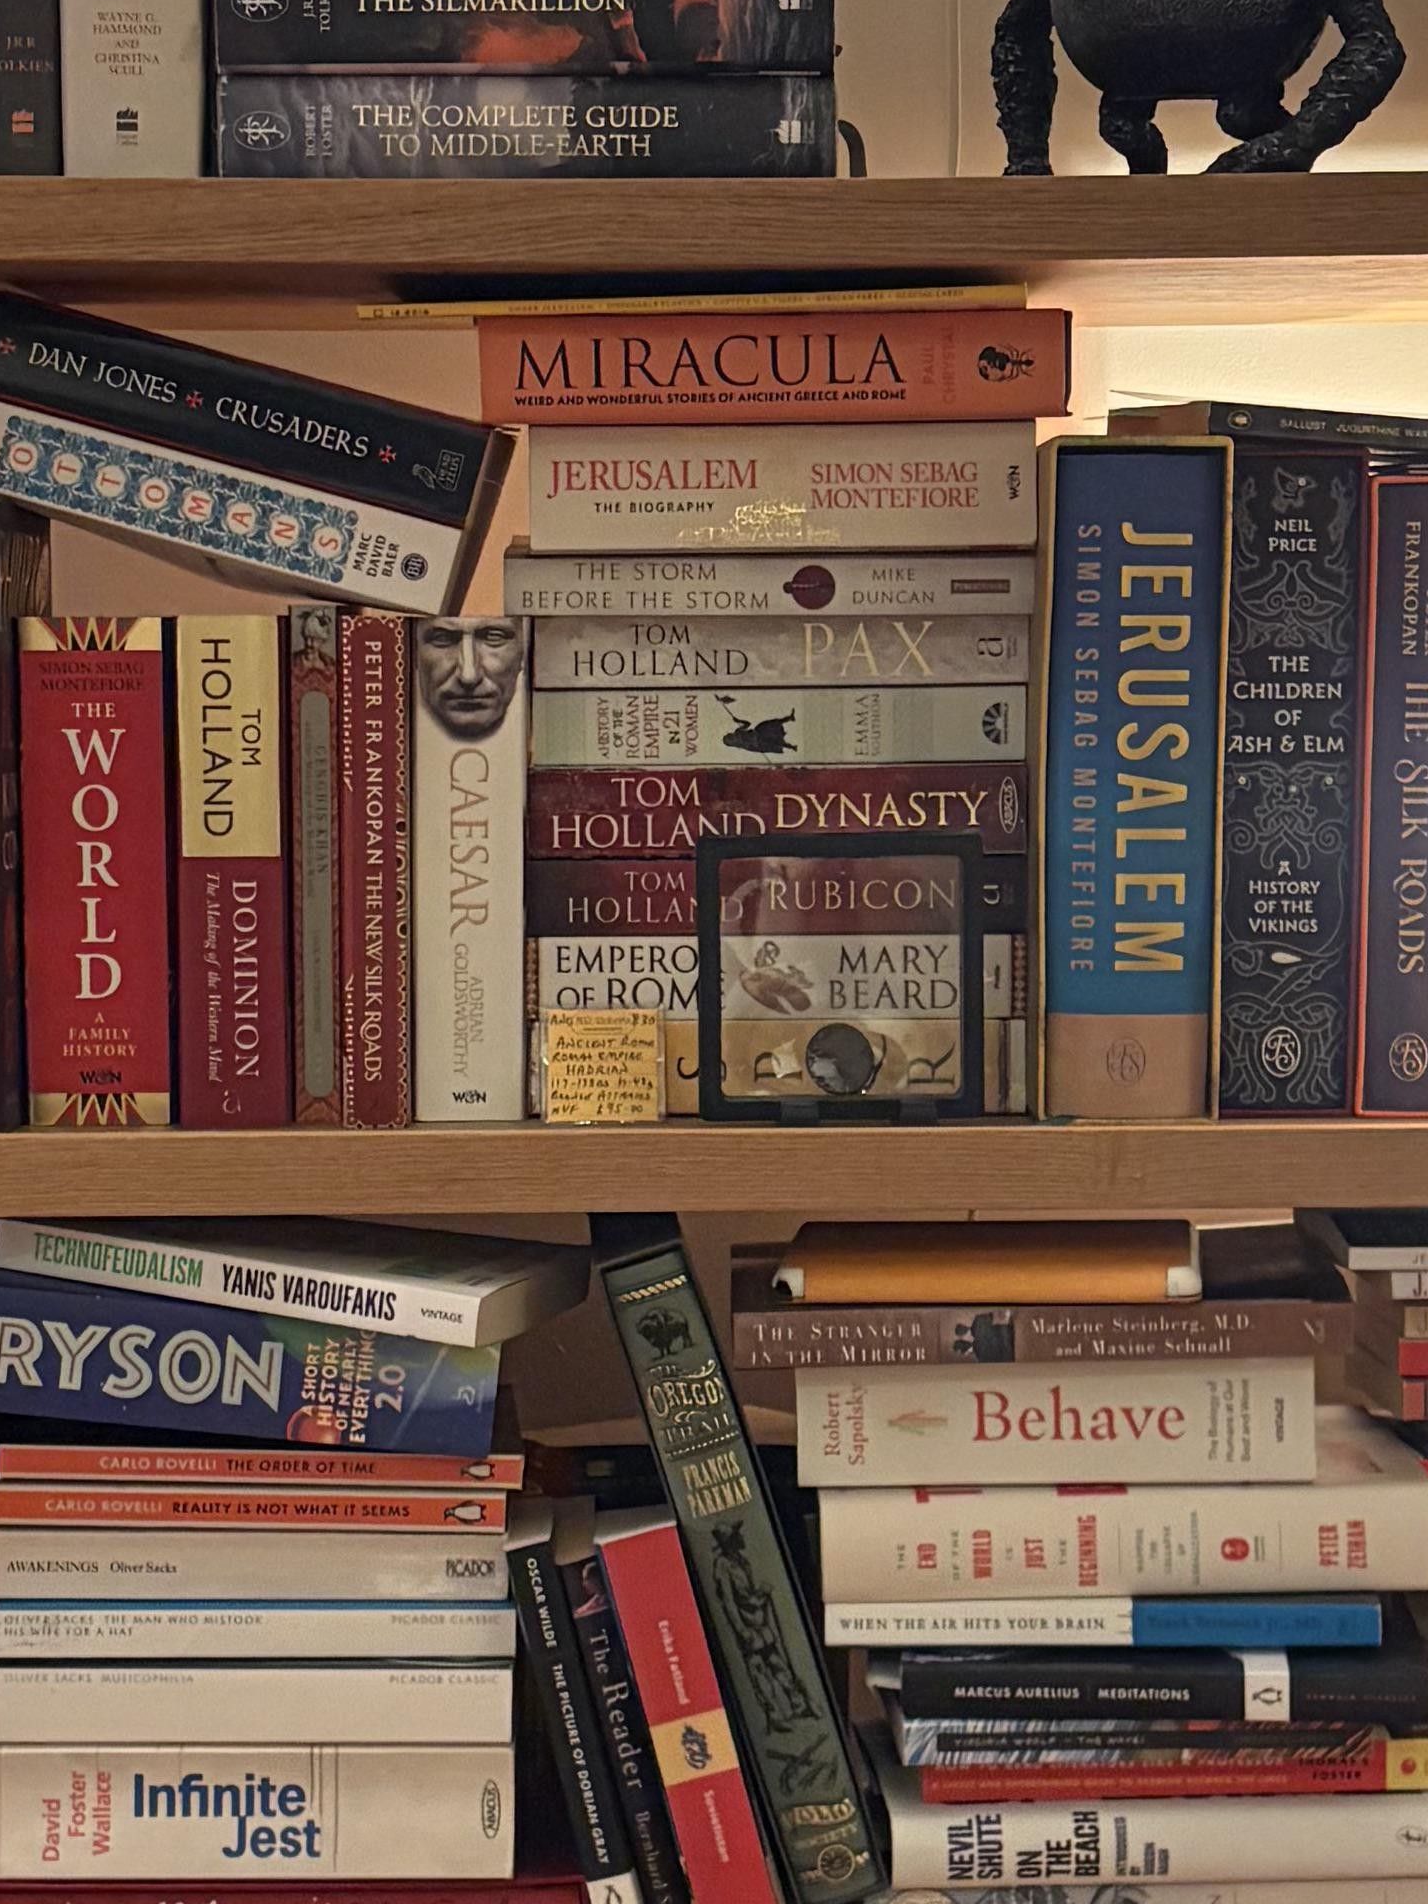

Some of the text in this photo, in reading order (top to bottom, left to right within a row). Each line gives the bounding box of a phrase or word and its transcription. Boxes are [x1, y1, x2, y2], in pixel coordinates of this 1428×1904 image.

[352, 104, 679, 128] THE COMPLETE GUIDE
[380, 134, 651, 157] TO MIDDLE-EARTH
[515, 333, 906, 390] MIRACULA
[28, 342, 369, 458] DAN JONES CRUSADERS
[515, 389, 905, 407] WEIRD AND WONDERFUL STORIES OF ANCIENT GREECE AND ROME
[547, 459, 758, 498] JERUSALEM
[811, 462, 978, 485] SIMON SEBAG
[595, 501, 714, 515] THE BIOGRAPHY
[811, 486, 980, 510] MONTEFIORE
[1274, 519, 1313, 534] NEIL
[352, 533, 372, 571] MARC
[366, 534, 388, 577] DAVID
[381, 543, 401, 577] BAER
[1269, 537, 1317, 553] PRICE
[803, 621, 934, 677] PAX
[1269, 656, 1310, 673] THE
[1233, 681, 1342, 700] CHILDREN
[72, 702, 115, 718] THE
[1274, 709, 1302, 726] OF
[201, 637, 233, 838] HOLLAND
[242, 708, 262, 767] TOM
[1114, 522, 1194, 972] JERUSALEM
[1229, 735, 1344, 753] ASH & ELM
[775, 791, 988, 828] DYNASTY
[449, 749, 489, 936] CAESAR
[63, 729, 124, 1001] WORLD
[770, 879, 956, 911] RUBICON
[838, 944, 949, 974] MARY
[231, 880, 259, 1078] DOMINION
[830, 979, 957, 1009] BEARD
[33, 1233, 397, 1321] TECHNOFEUDALISM YANIS VAROUFAKIS
[972, 1386, 1185, 1443] Behave
[171, 1503, 409, 1518] REALITY IS NOT WHAT IT SEEMS
[7, 1560, 98, 1573] AWAKENINGS
[134, 1773, 307, 1818] Infinite
[222, 1813, 321, 1859] Jest
[948, 1818, 973, 1880] NEVIL
[977, 1813, 1002, 1879] SHUTE
